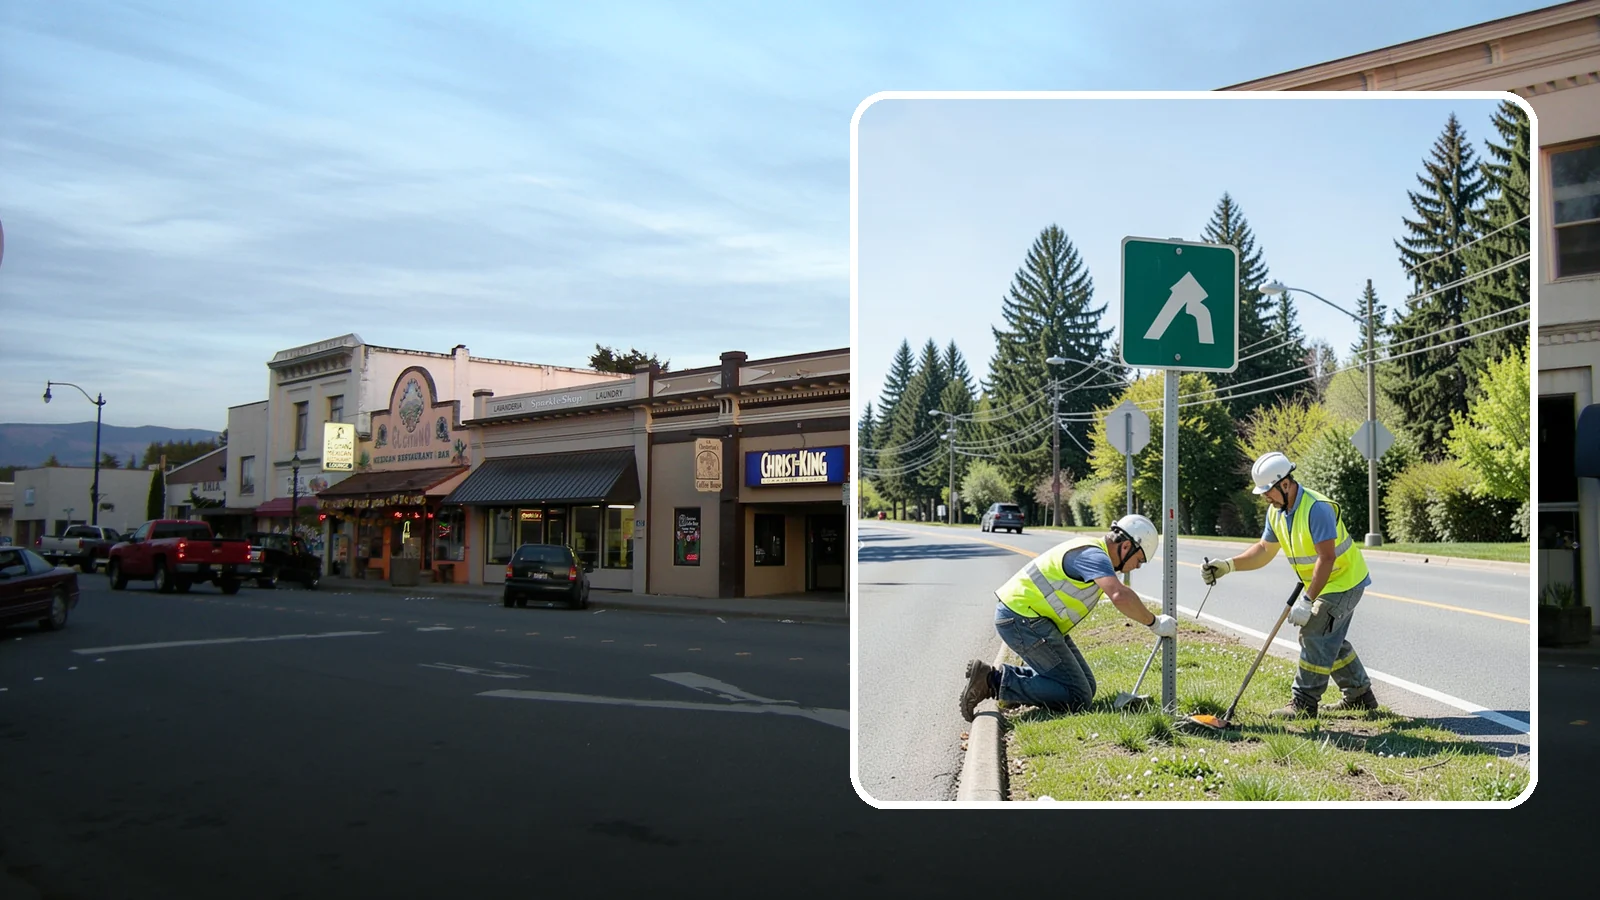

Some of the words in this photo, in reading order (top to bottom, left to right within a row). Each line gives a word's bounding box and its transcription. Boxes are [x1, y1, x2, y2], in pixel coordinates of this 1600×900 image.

[595, 389, 623, 399] LAUNDRY
[493, 402, 522, 412] LAVANDERIA
[531, 397, 561, 408] Sparkle
[562, 394, 582, 404] Shop
[373, 455, 396, 464] MEXICAN
[398, 451, 433, 462] RESTAURANT
[438, 450, 450, 458] BAR
[761, 452, 797, 478] CHRIST
[799, 450, 827, 476] KING
[696, 481, 709, 489] Coffee
[710, 481, 722, 489] House
